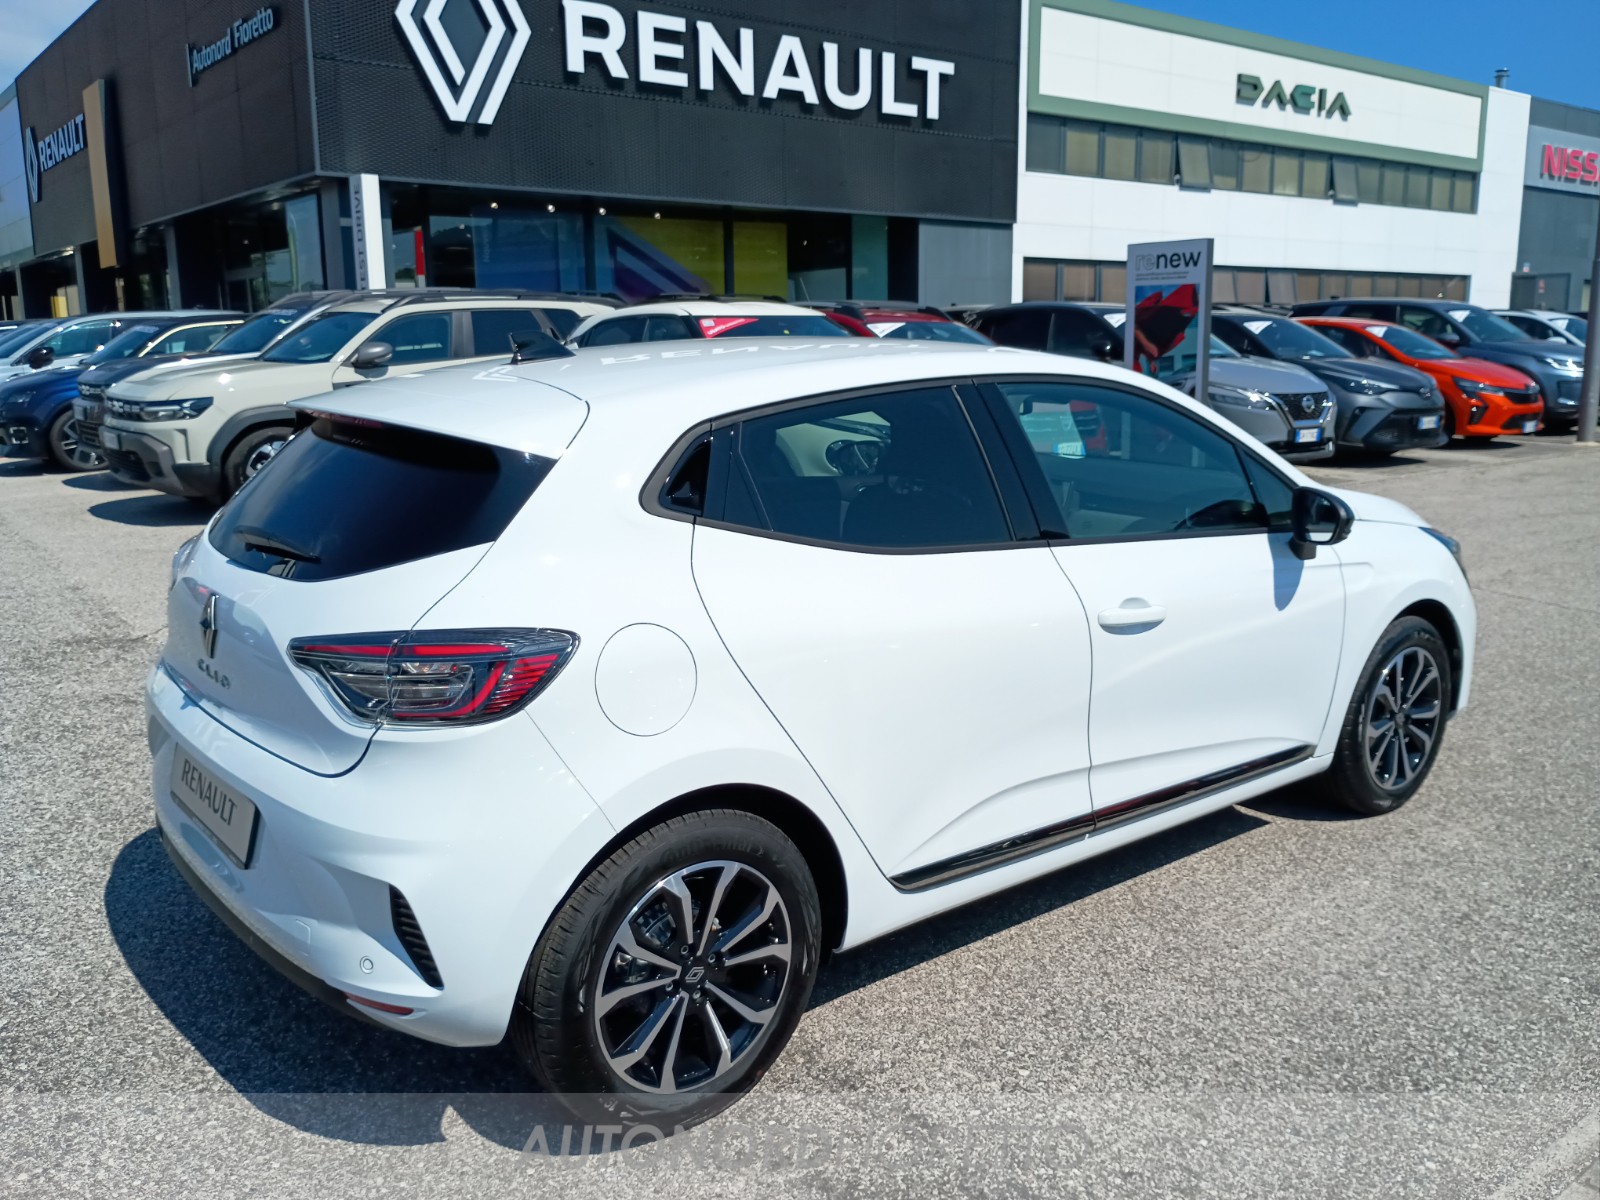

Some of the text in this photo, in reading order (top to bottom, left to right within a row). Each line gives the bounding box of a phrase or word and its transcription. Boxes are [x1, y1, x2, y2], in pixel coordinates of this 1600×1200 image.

[192, 7, 274, 74] Autonord Fioretto
[562, 0, 956, 121] RENAULT
[1236, 73, 1351, 121] DACIA
[38, 113, 85, 173] RENAULT
[1543, 144, 1600, 184] NISS
[353, 183, 364, 243] DRIVE
[181, 757, 238, 826] RENAULT
